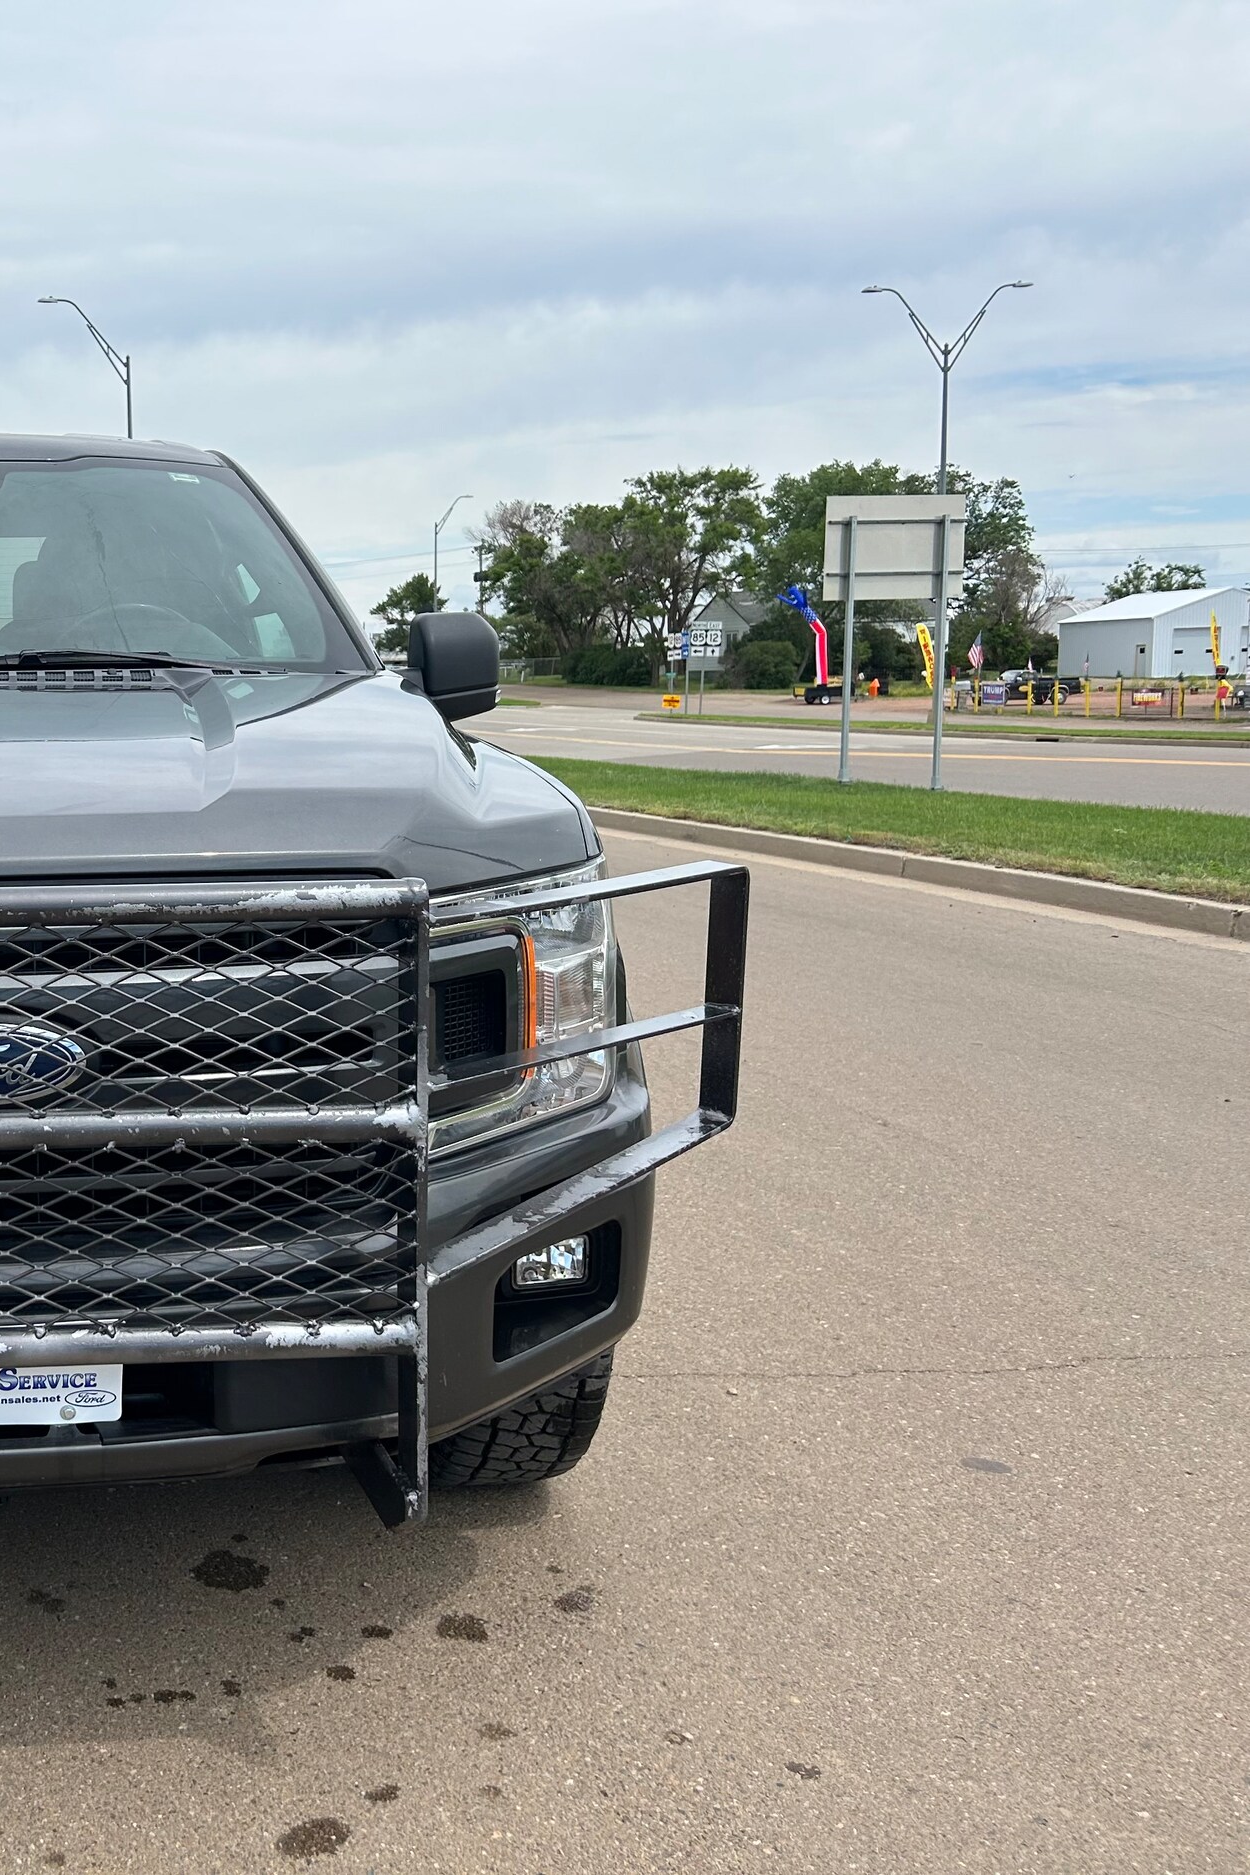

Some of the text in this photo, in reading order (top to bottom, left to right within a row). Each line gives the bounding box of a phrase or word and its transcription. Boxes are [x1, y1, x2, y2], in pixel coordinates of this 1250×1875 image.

[692, 633, 705, 642] 85
[709, 633, 719, 642] 12
[983, 685, 1004, 695] TRUMP
[74, 1391, 106, 1404] Ford
